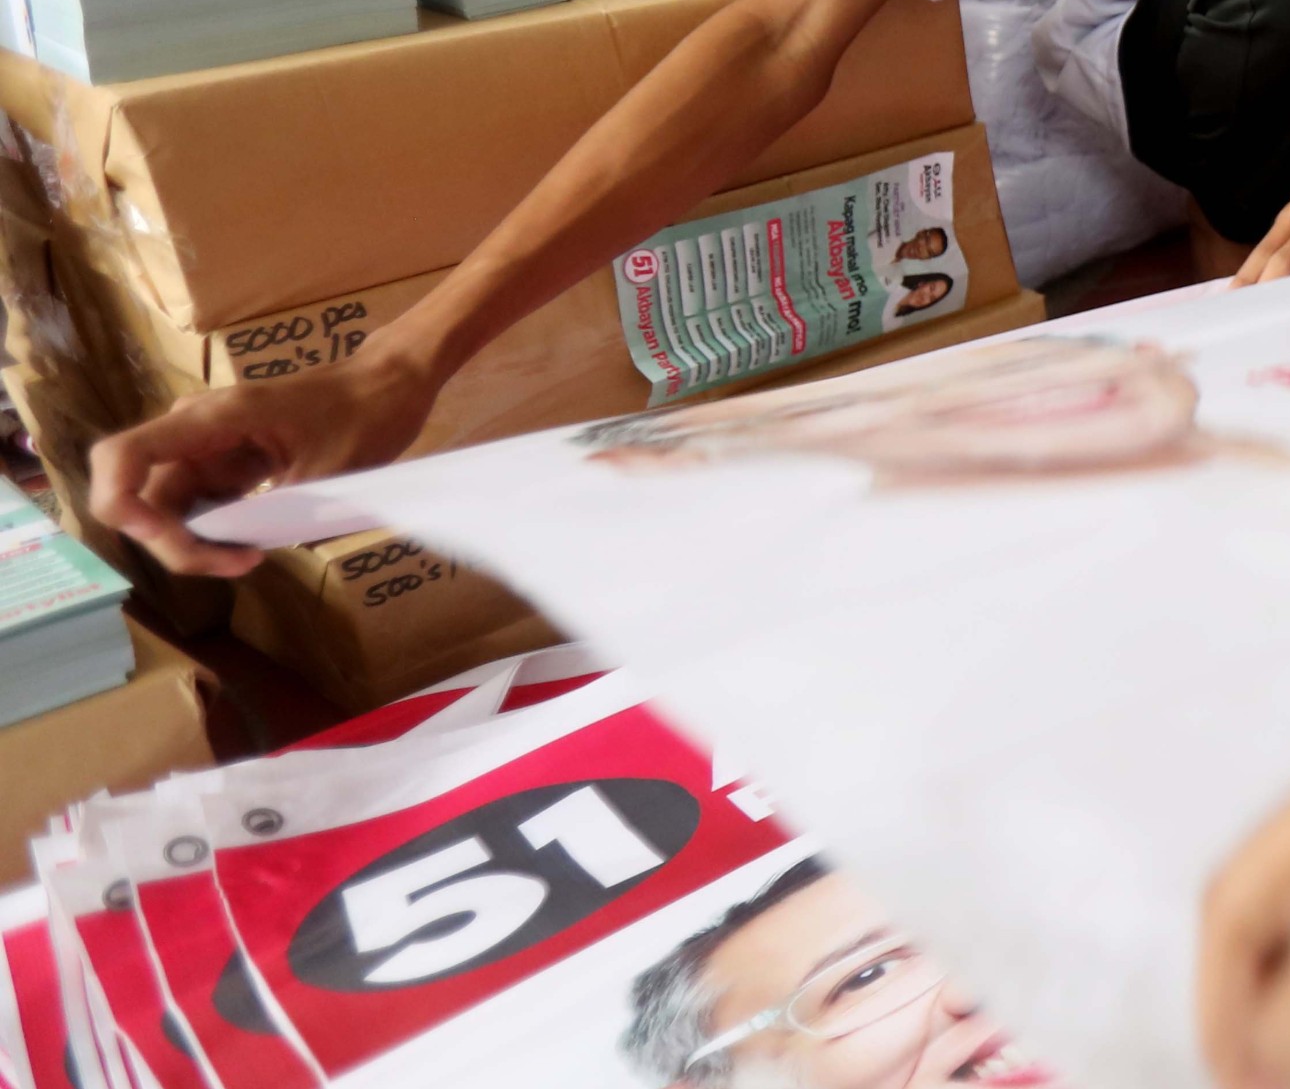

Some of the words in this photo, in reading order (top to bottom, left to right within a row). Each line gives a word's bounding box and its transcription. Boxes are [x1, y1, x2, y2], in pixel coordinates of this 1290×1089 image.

[632, 255, 653, 277] 51
[827, 220, 856, 300] Akbayan
[845, 236, 860, 272] mahal
[226, 316, 314, 356] 5000
[636, 286, 660, 350] Akbayan
[342, 784, 666, 984] 51
